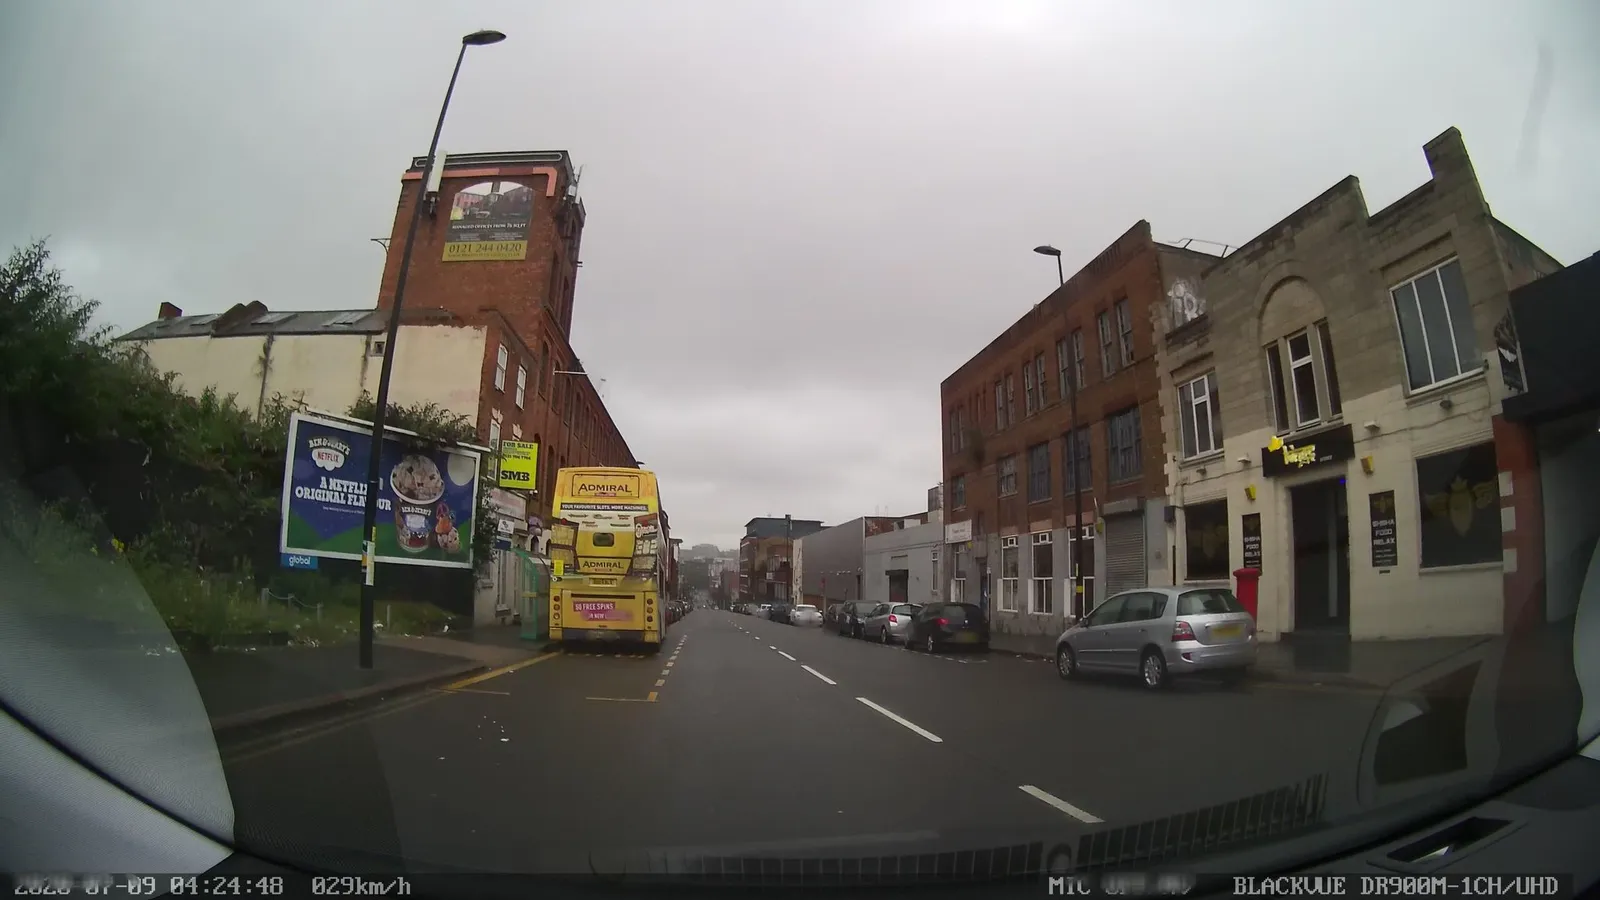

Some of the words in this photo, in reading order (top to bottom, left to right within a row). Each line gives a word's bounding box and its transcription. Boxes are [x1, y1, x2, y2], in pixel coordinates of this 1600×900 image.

[449, 243, 472, 253] 0121
[475, 243, 494, 252] 244
[496, 242, 522, 252] 0420
[517, 442, 534, 450] SALE
[317, 451, 339, 463] NETFLIX
[501, 470, 530, 482] SMB
[320, 476, 327, 489] A
[579, 483, 632, 493] ADMIRAL
[295, 486, 346, 505] ORIGINAL
[347, 493, 391, 511] FLAUR
[1375, 528, 1393, 537] FOOD
[1373, 538, 1395, 546] RELAX
[288, 555, 311, 567] global
[582, 560, 624, 569] ADMIRAL
[583, 603, 597, 611] FREE
[597, 602, 614, 610] SPINS
